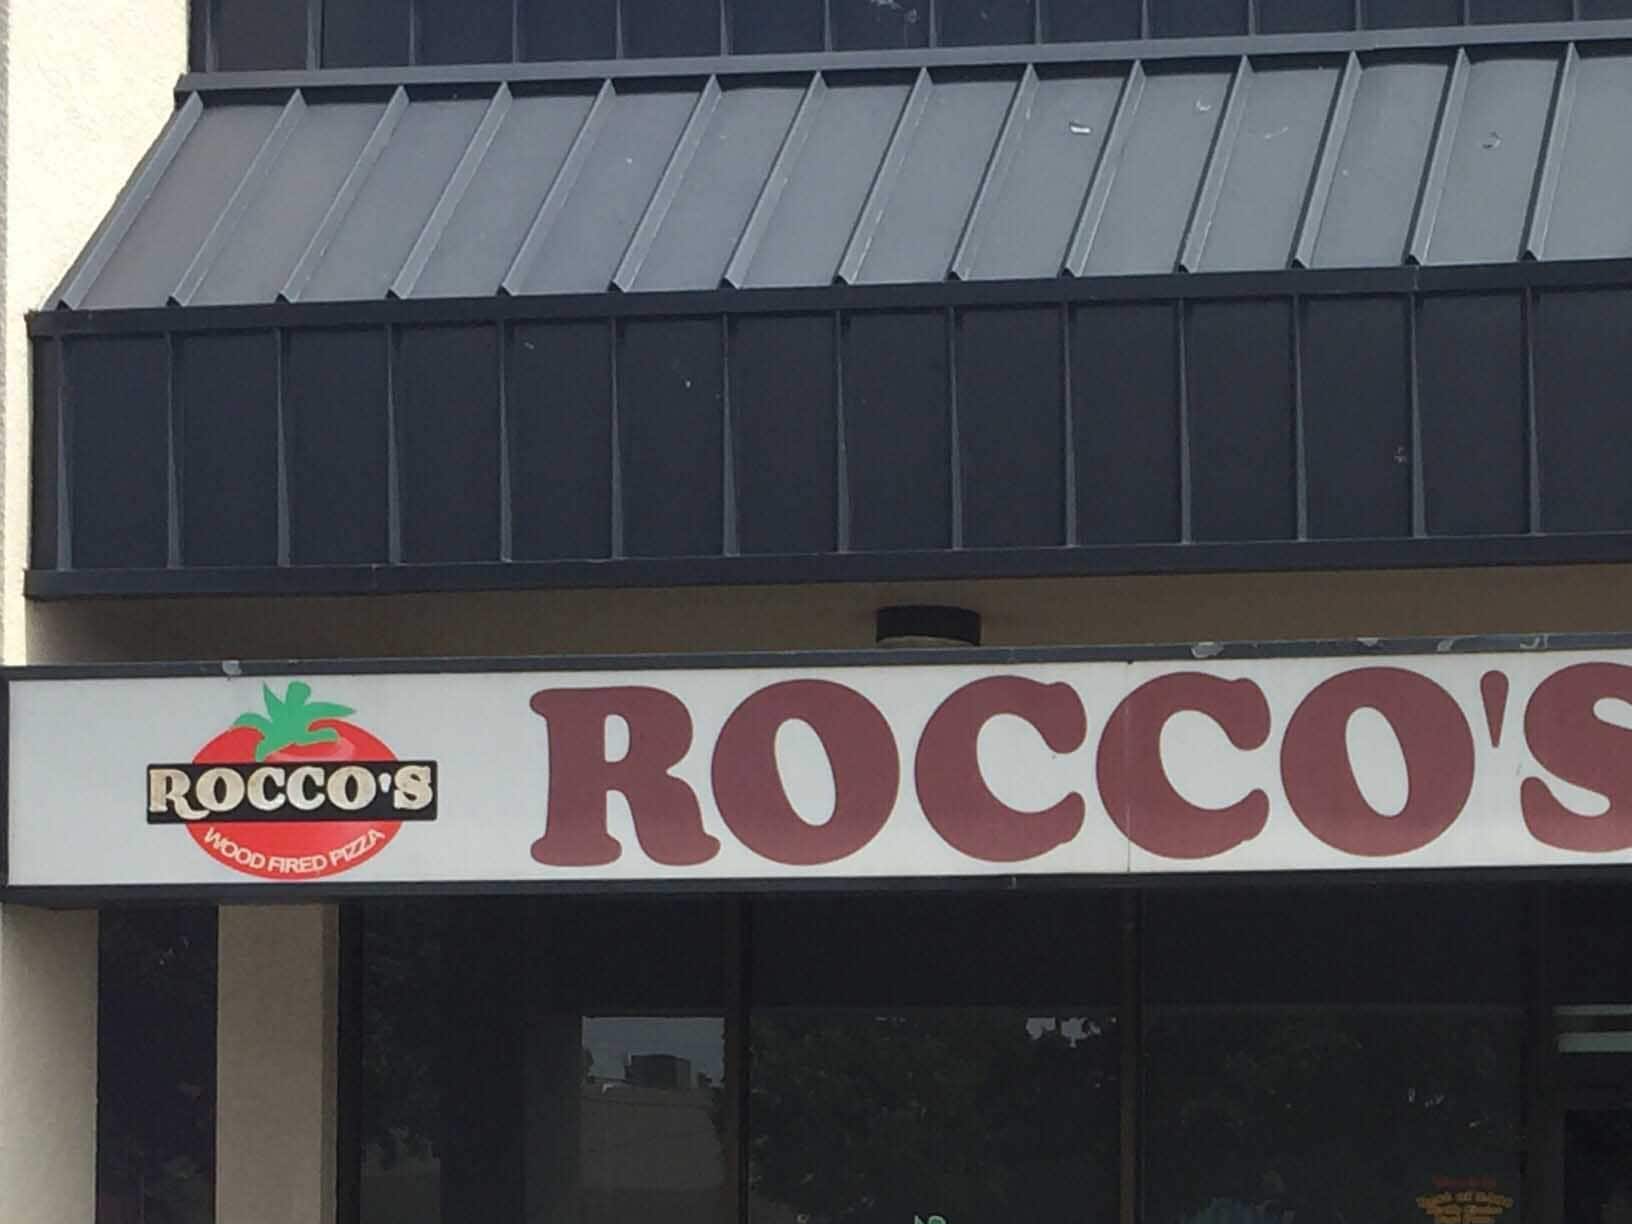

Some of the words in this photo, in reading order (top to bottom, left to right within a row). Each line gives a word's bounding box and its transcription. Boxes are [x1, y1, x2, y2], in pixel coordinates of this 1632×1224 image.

[149, 765, 434, 820] ROCCO'S
[204, 827, 266, 869] WOOD
[268, 854, 328, 873] FIRED
[329, 828, 386, 867] PIZZA
